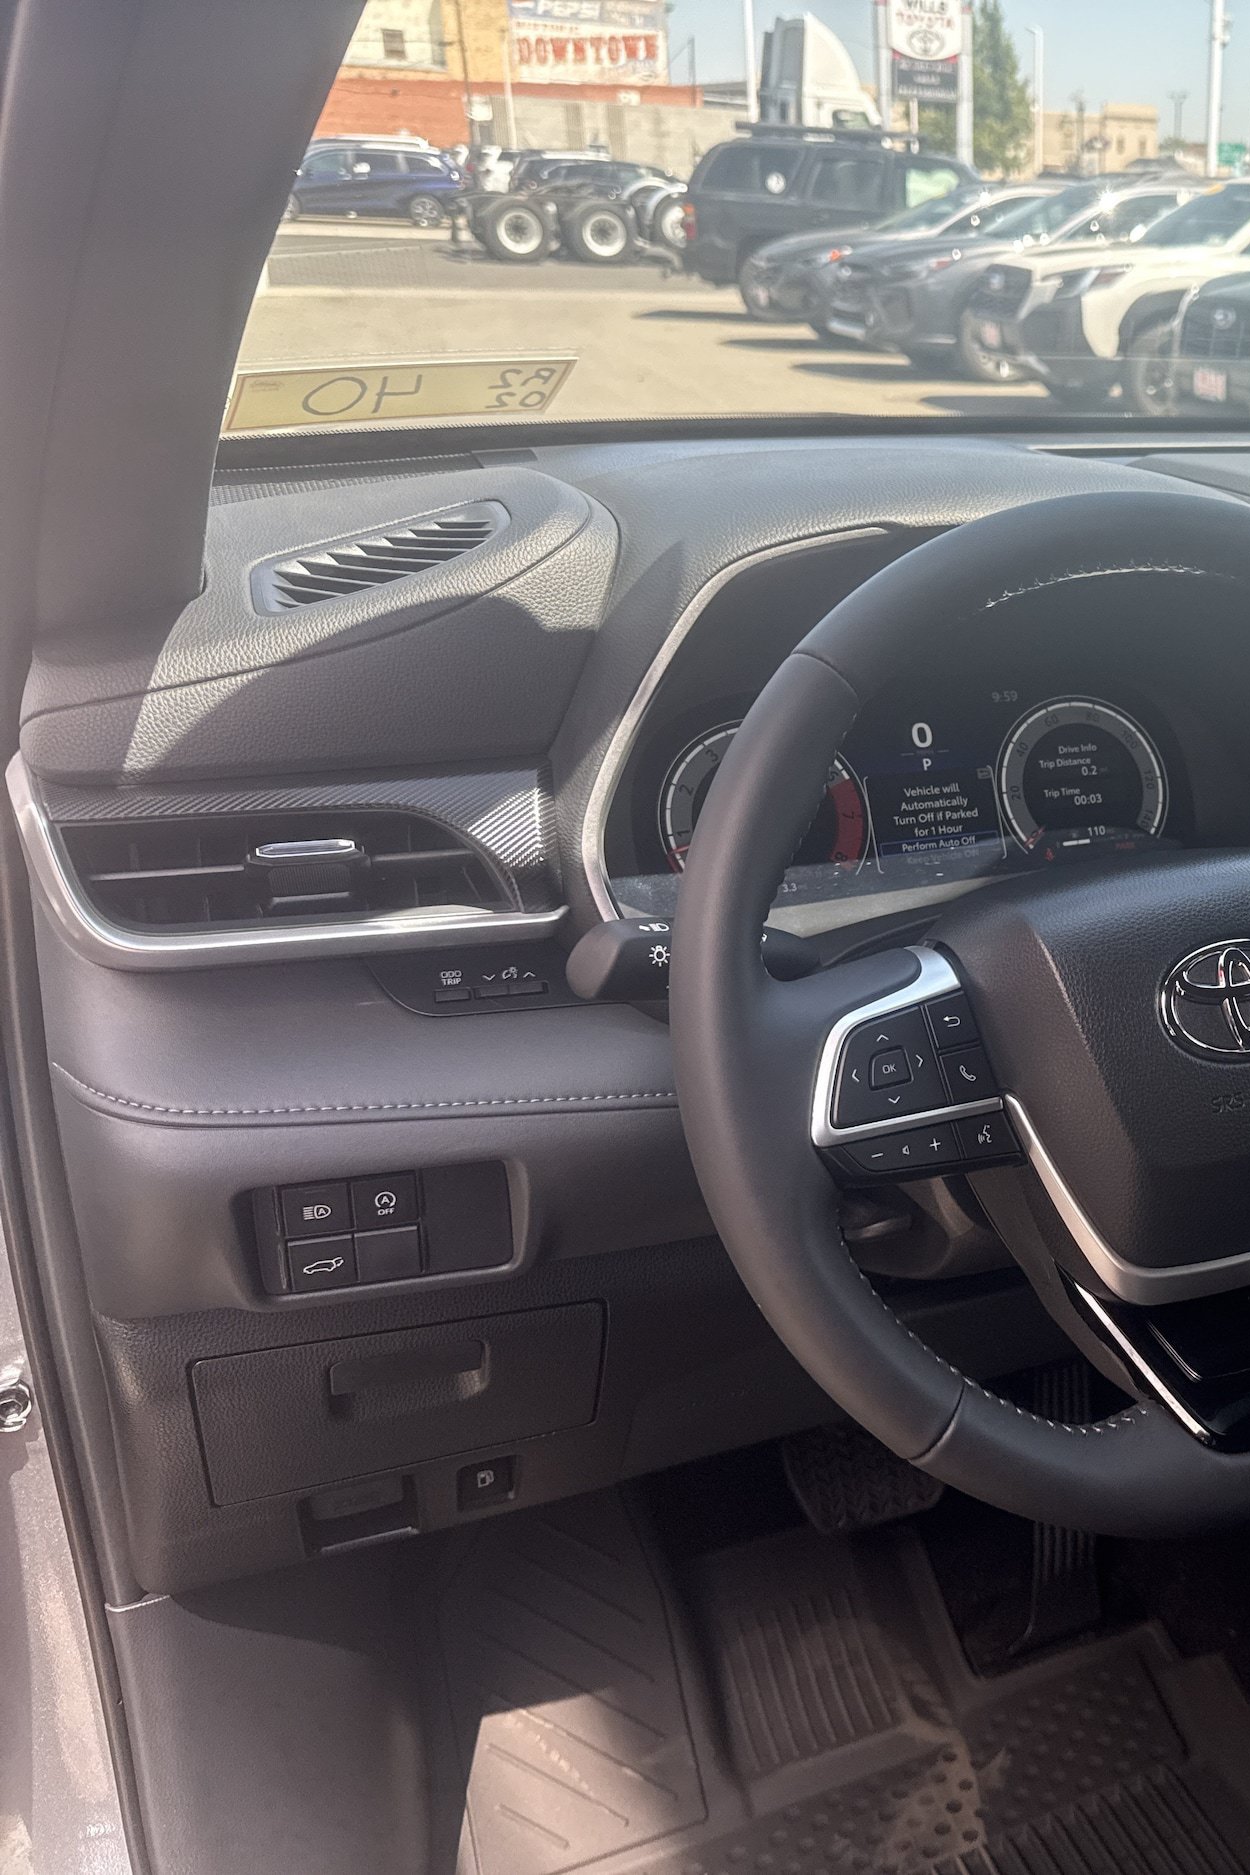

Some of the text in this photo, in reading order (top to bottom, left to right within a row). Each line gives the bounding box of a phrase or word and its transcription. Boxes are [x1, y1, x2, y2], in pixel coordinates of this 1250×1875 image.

[517, 35, 658, 65] DOWNTOWN
[991, 690, 1018, 703] 9:59
[911, 722, 933, 748] 0
[1058, 743, 1098, 754] Drive Info
[705, 749, 719, 762] 3
[922, 757, 932, 772] P
[1038, 757, 1091, 770] Trip Distance
[1081, 766, 1098, 776] 0.2
[680, 784, 695, 797] 2
[903, 782, 960, 797] Vehicle will
[1044, 787, 1081, 799] Trip Time
[900, 796, 969, 811] Automatically
[1073, 793, 1103, 806] 00:03
[893, 807, 979, 826] Turn Off if Parked
[914, 827, 929, 838] for
[938, 824, 963, 835] Hour
[1087, 825, 1106, 837] 110
[901, 835, 976, 853] Perform Auto Off
[441, 977, 461, 986] TRIP
[882, 1063, 897, 1075] OK
[377, 1207, 395, 1216] OFF
